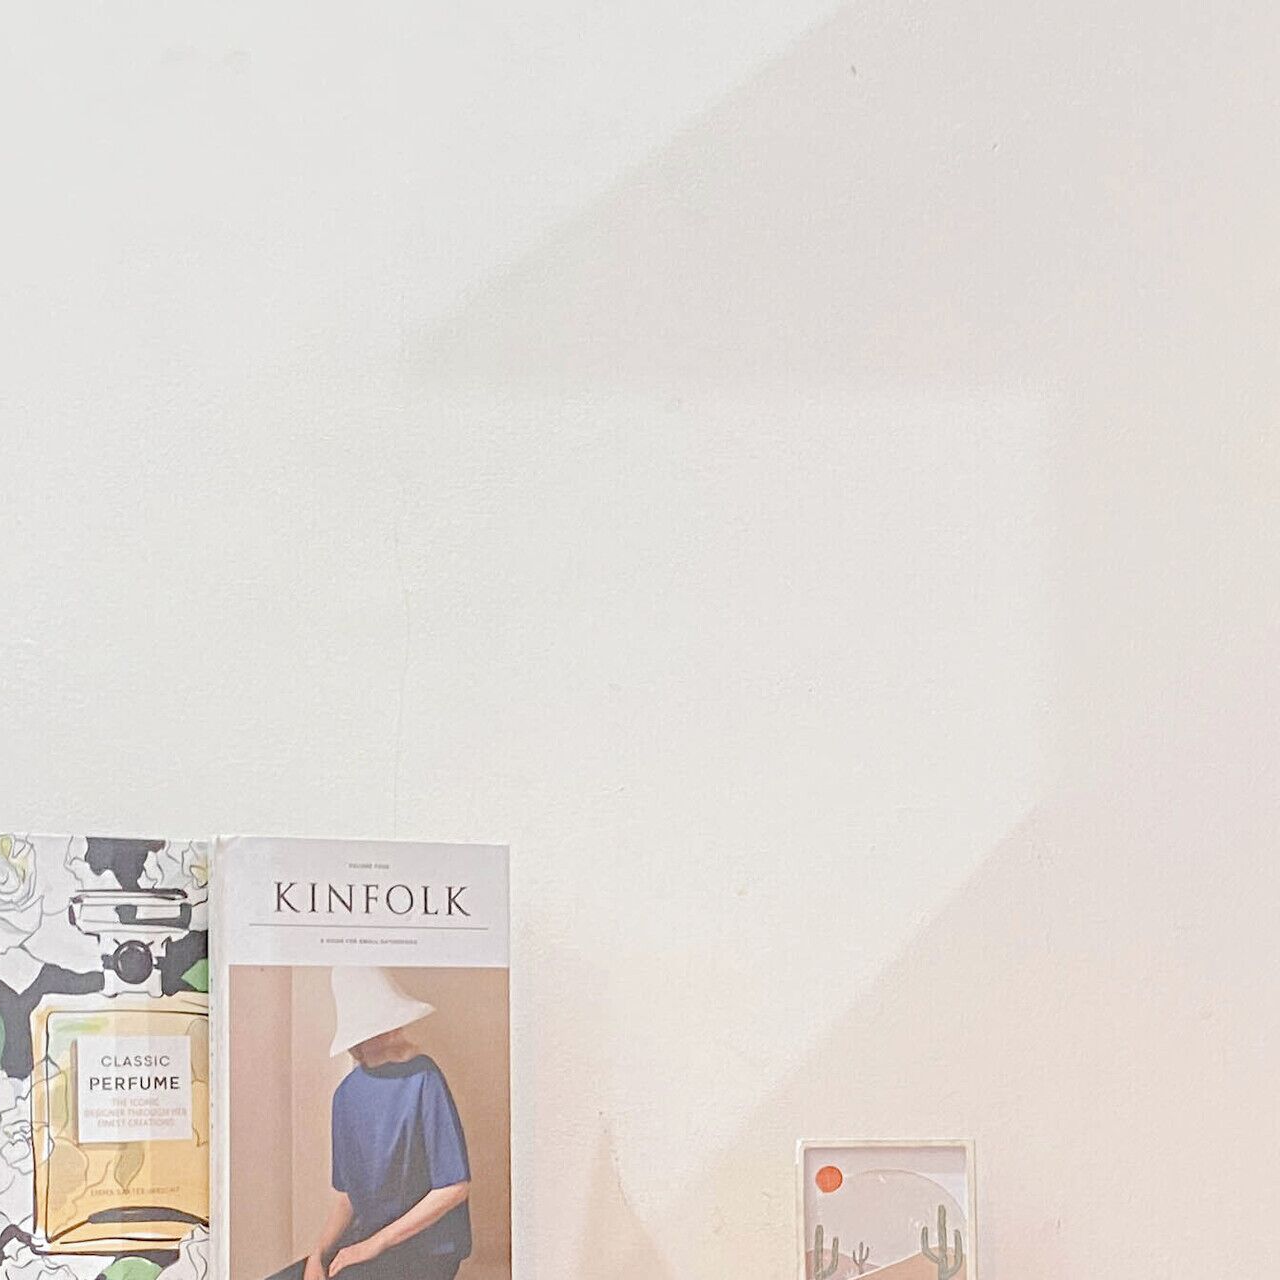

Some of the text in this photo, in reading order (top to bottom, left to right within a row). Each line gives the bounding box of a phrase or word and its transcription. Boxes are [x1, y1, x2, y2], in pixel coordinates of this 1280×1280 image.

[274, 881, 471, 917] KINFOLK
[101, 1055, 170, 1068] CLASSIC
[89, 1076, 181, 1090] PERFUME
